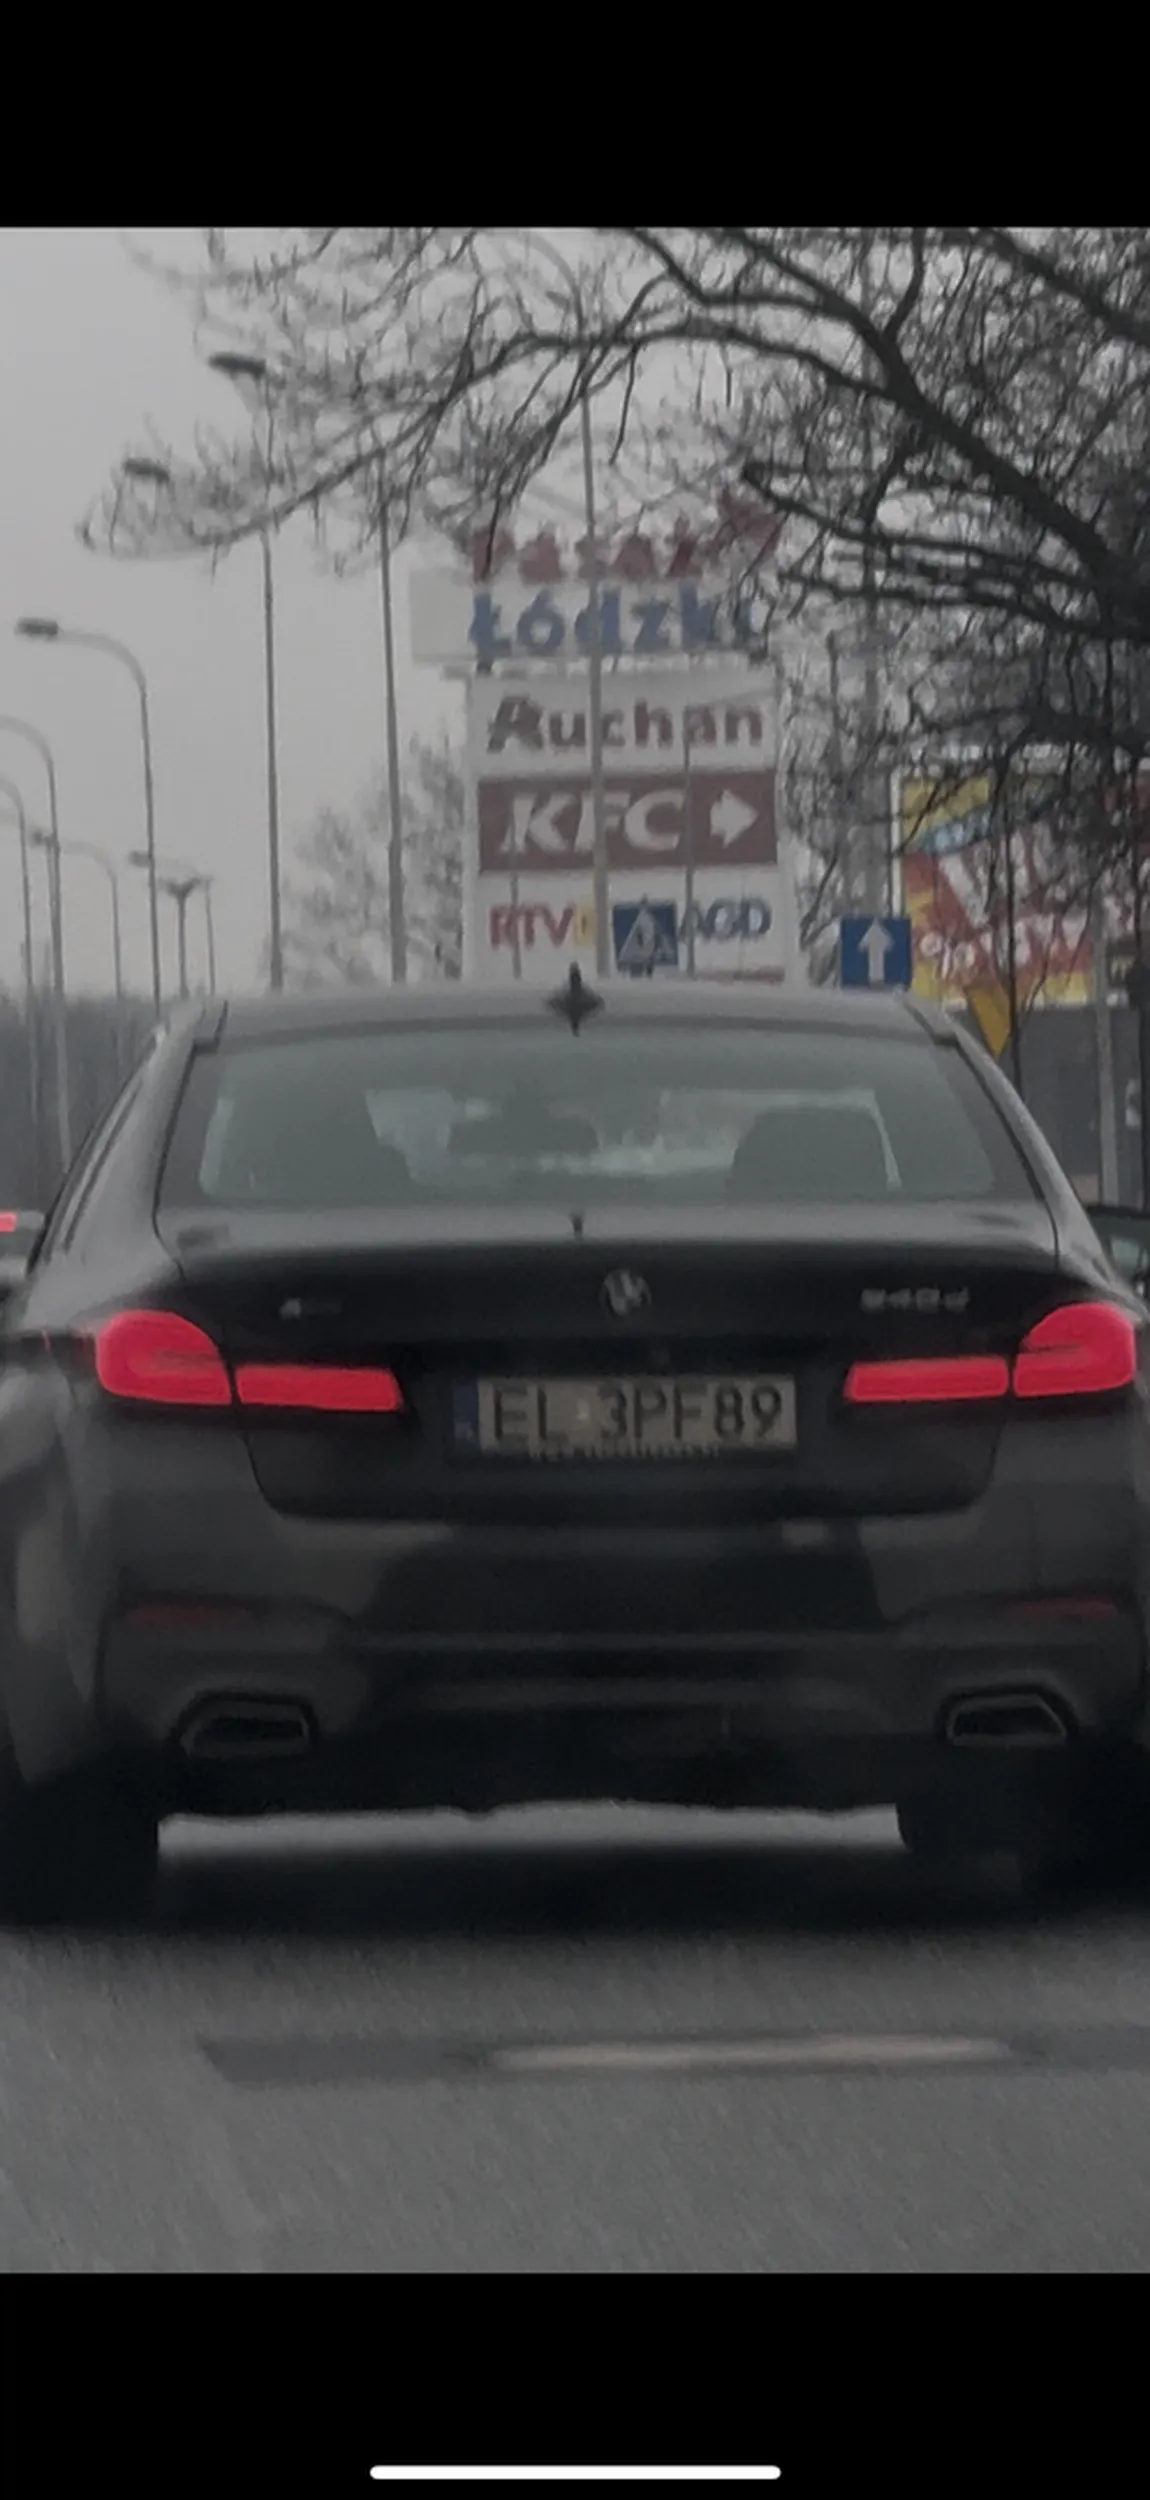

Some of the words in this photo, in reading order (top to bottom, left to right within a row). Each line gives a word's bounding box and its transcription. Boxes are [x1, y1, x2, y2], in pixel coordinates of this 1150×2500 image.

[486, 696, 764, 753] Auchan
[499, 789, 686, 853] KFC
[488, 902, 573, 948] RTV
[679, 897, 773, 944] AGD
[493, 1382, 570, 1444] EL
[596, 1381, 783, 1441] 3PF89
